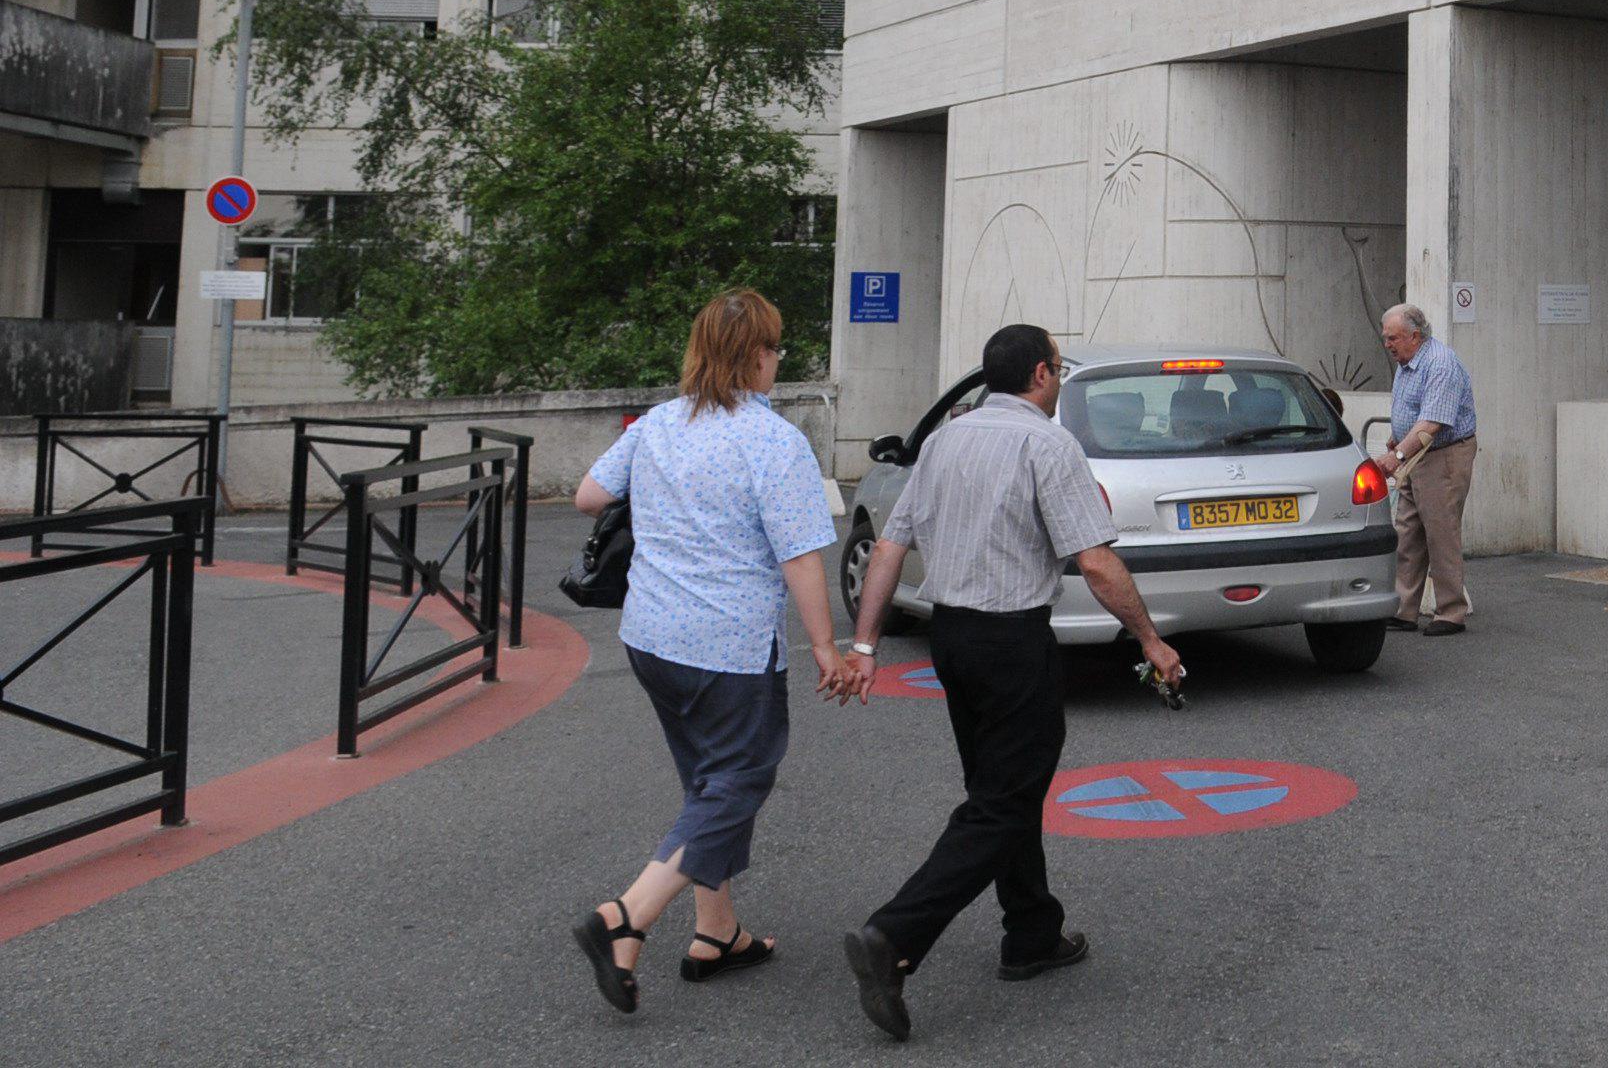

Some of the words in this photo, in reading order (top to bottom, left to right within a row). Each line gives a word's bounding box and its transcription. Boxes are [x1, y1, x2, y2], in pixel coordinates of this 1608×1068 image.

[868, 278, 881, 294] P
[1193, 502, 1241, 525] 8357
[1271, 499, 1296, 520] 32
